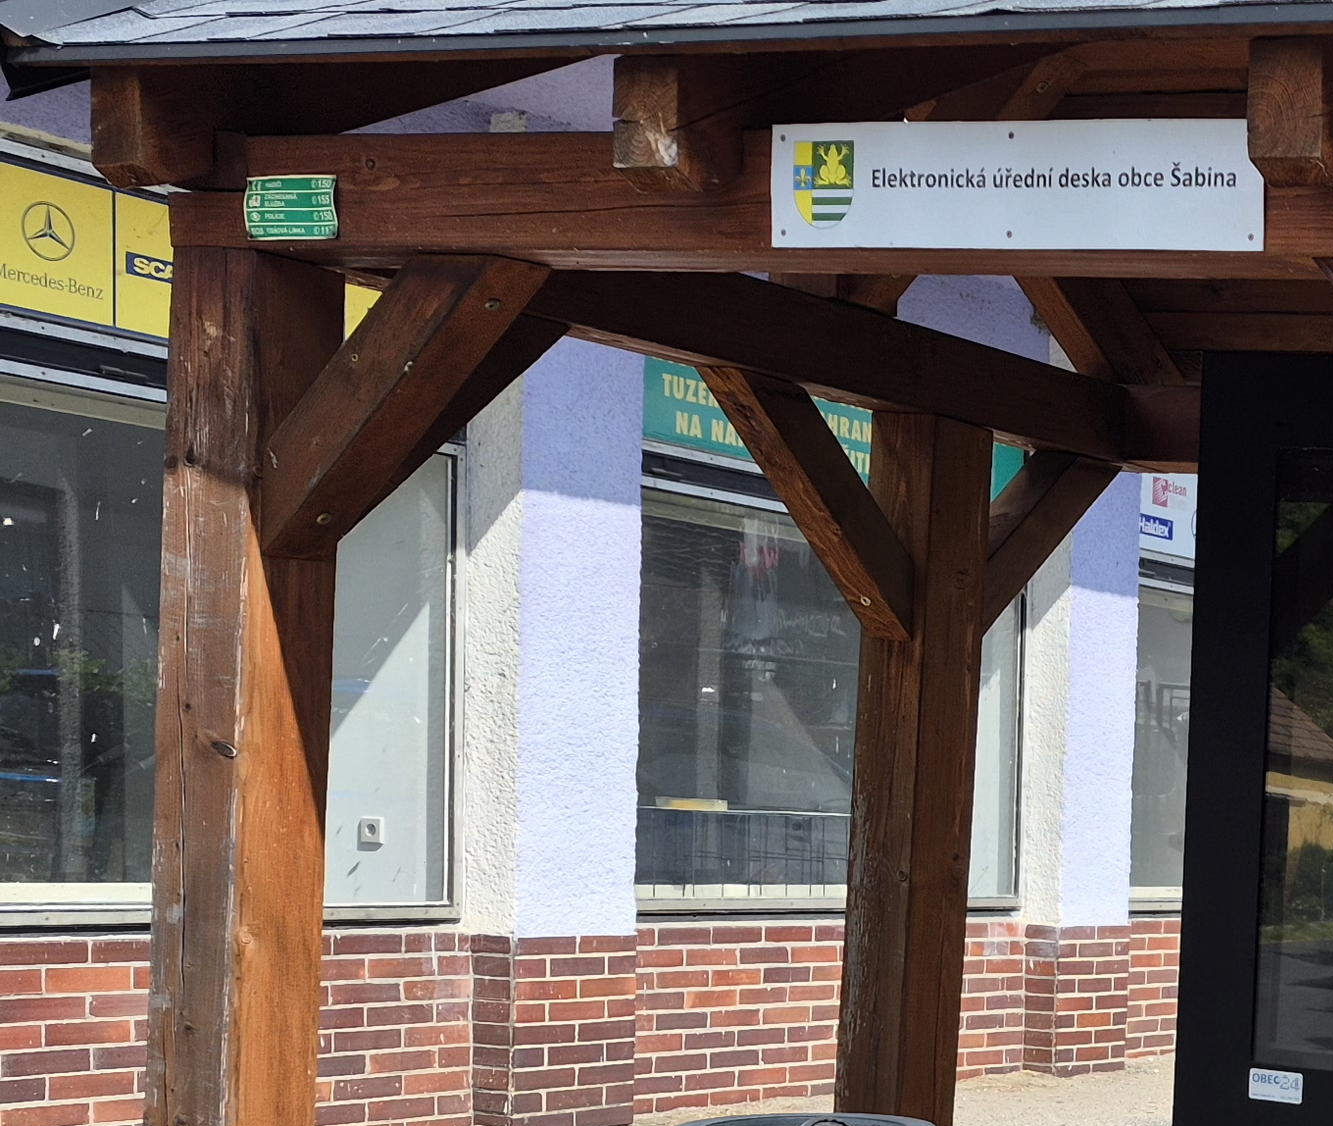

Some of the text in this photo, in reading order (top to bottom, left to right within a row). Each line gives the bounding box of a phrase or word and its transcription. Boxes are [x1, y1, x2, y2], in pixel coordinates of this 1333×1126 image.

[871, 161, 1238, 190] Elektronická úřední deska obce Šabina
[676, 411, 702, 438] NA
